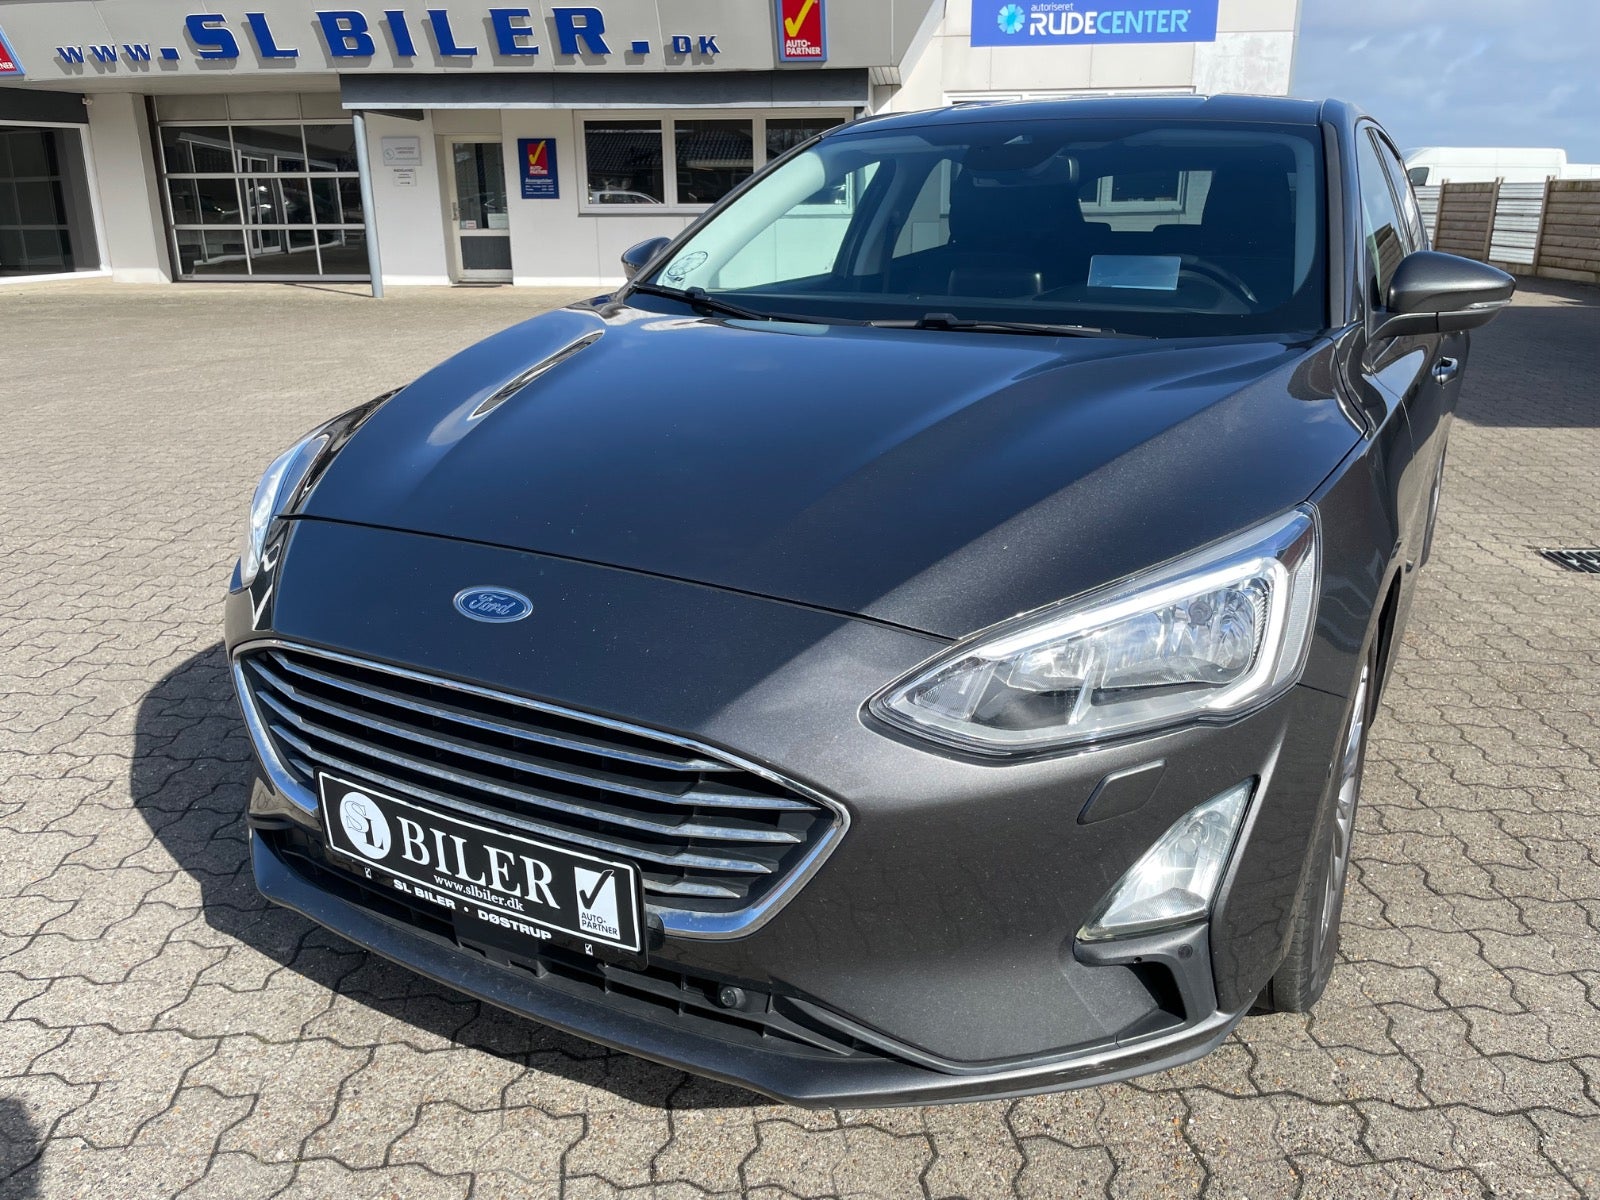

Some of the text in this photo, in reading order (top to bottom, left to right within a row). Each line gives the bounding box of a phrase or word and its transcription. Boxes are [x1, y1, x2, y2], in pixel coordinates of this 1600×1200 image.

[1030, 2, 1073, 12] autoriseret
[1030, 9, 1189, 36] RUDECENTER
[786, 39, 811, 48] AUTO-
[786, 46, 821, 55] PARTNER
[469, 593, 516, 615] Ford
[396, 815, 561, 910] BILER
[433, 874, 525, 913] www.slbiler.dk
[393, 878, 552, 941] SL BILER DØSTRUP
[581, 911, 606, 924] AUTO-
[581, 919, 618, 936] PARTNER
